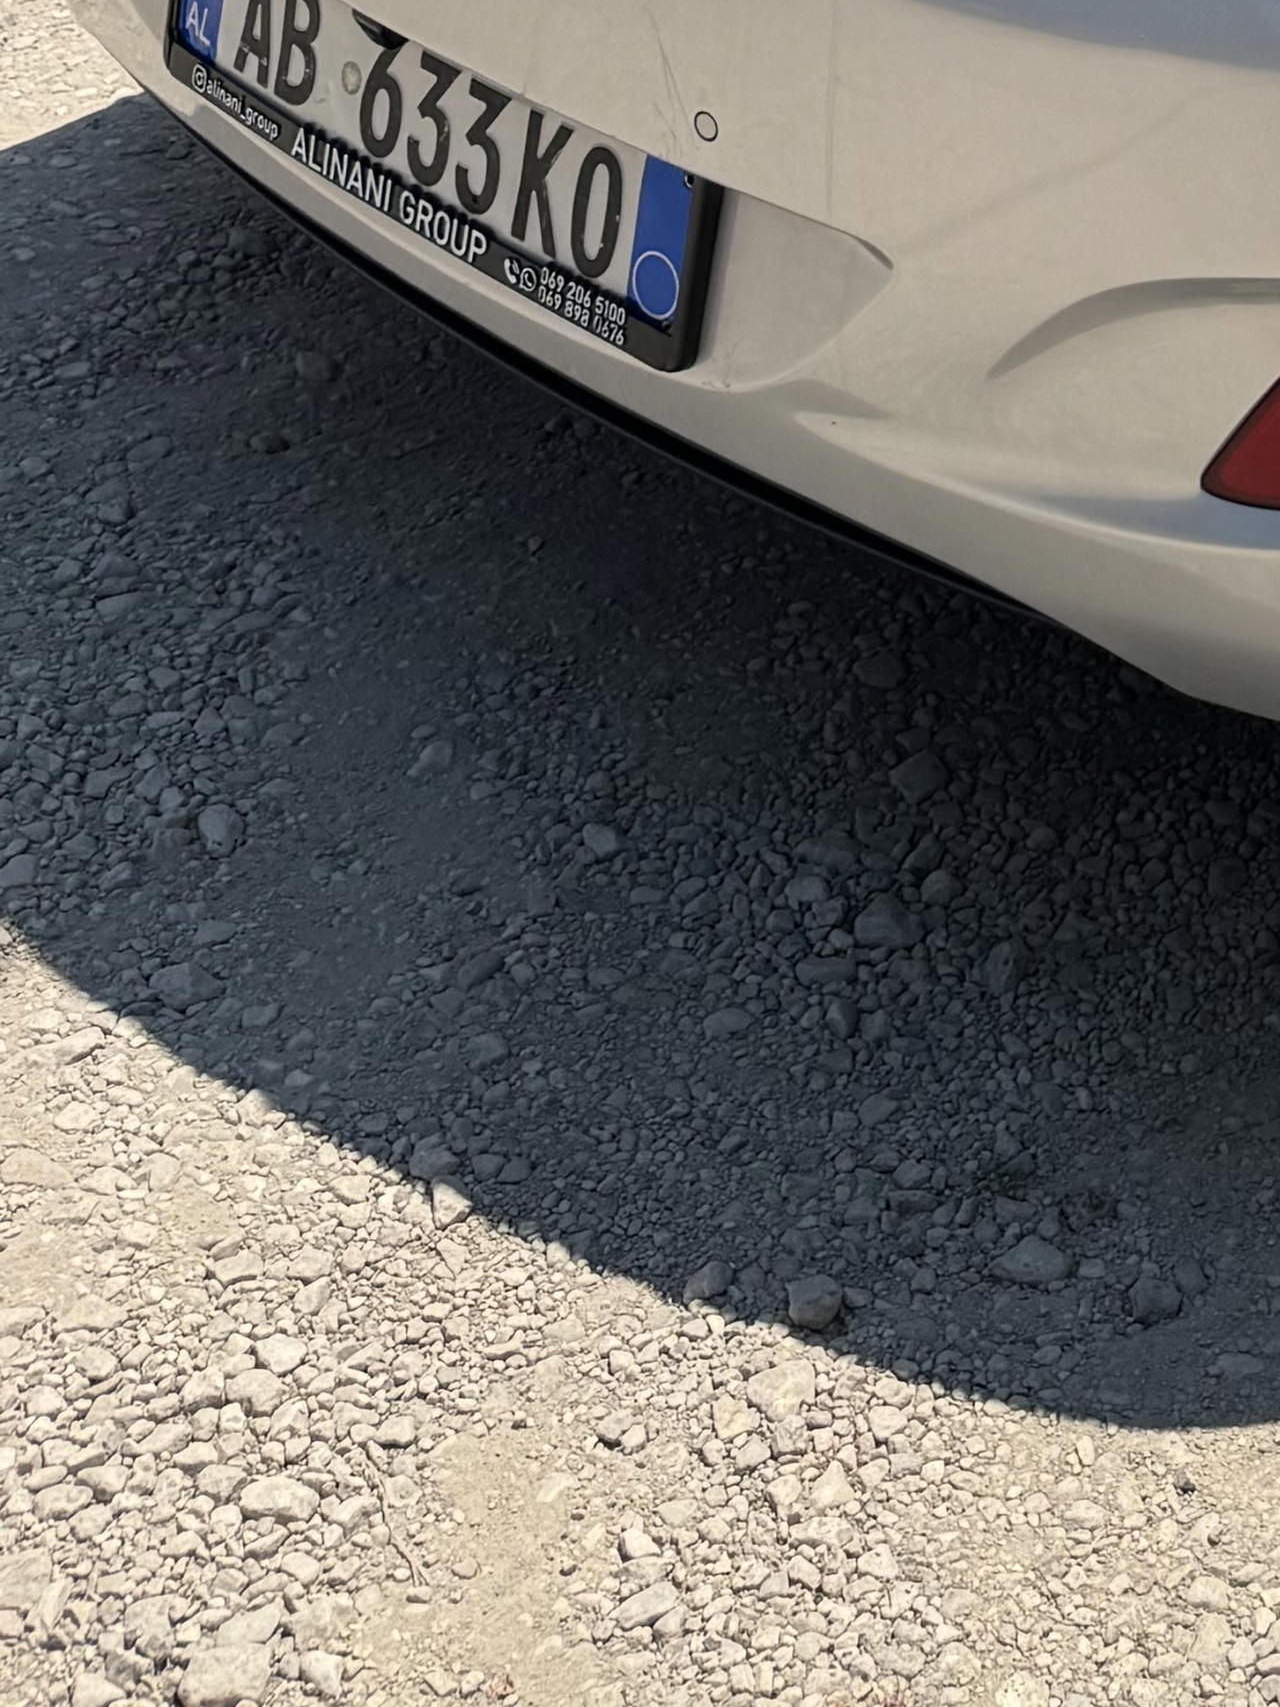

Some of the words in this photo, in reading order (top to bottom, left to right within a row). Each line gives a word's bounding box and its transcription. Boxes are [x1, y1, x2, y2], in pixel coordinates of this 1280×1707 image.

[186, 2, 211, 47] AL
[291, 127, 395, 214] ALINANI
[400, 190, 488, 264] GROUP
[537, 286, 562, 310] 069
[539, 267, 565, 291] 069
[566, 282, 592, 308] 206
[594, 297, 627, 326] 5100
